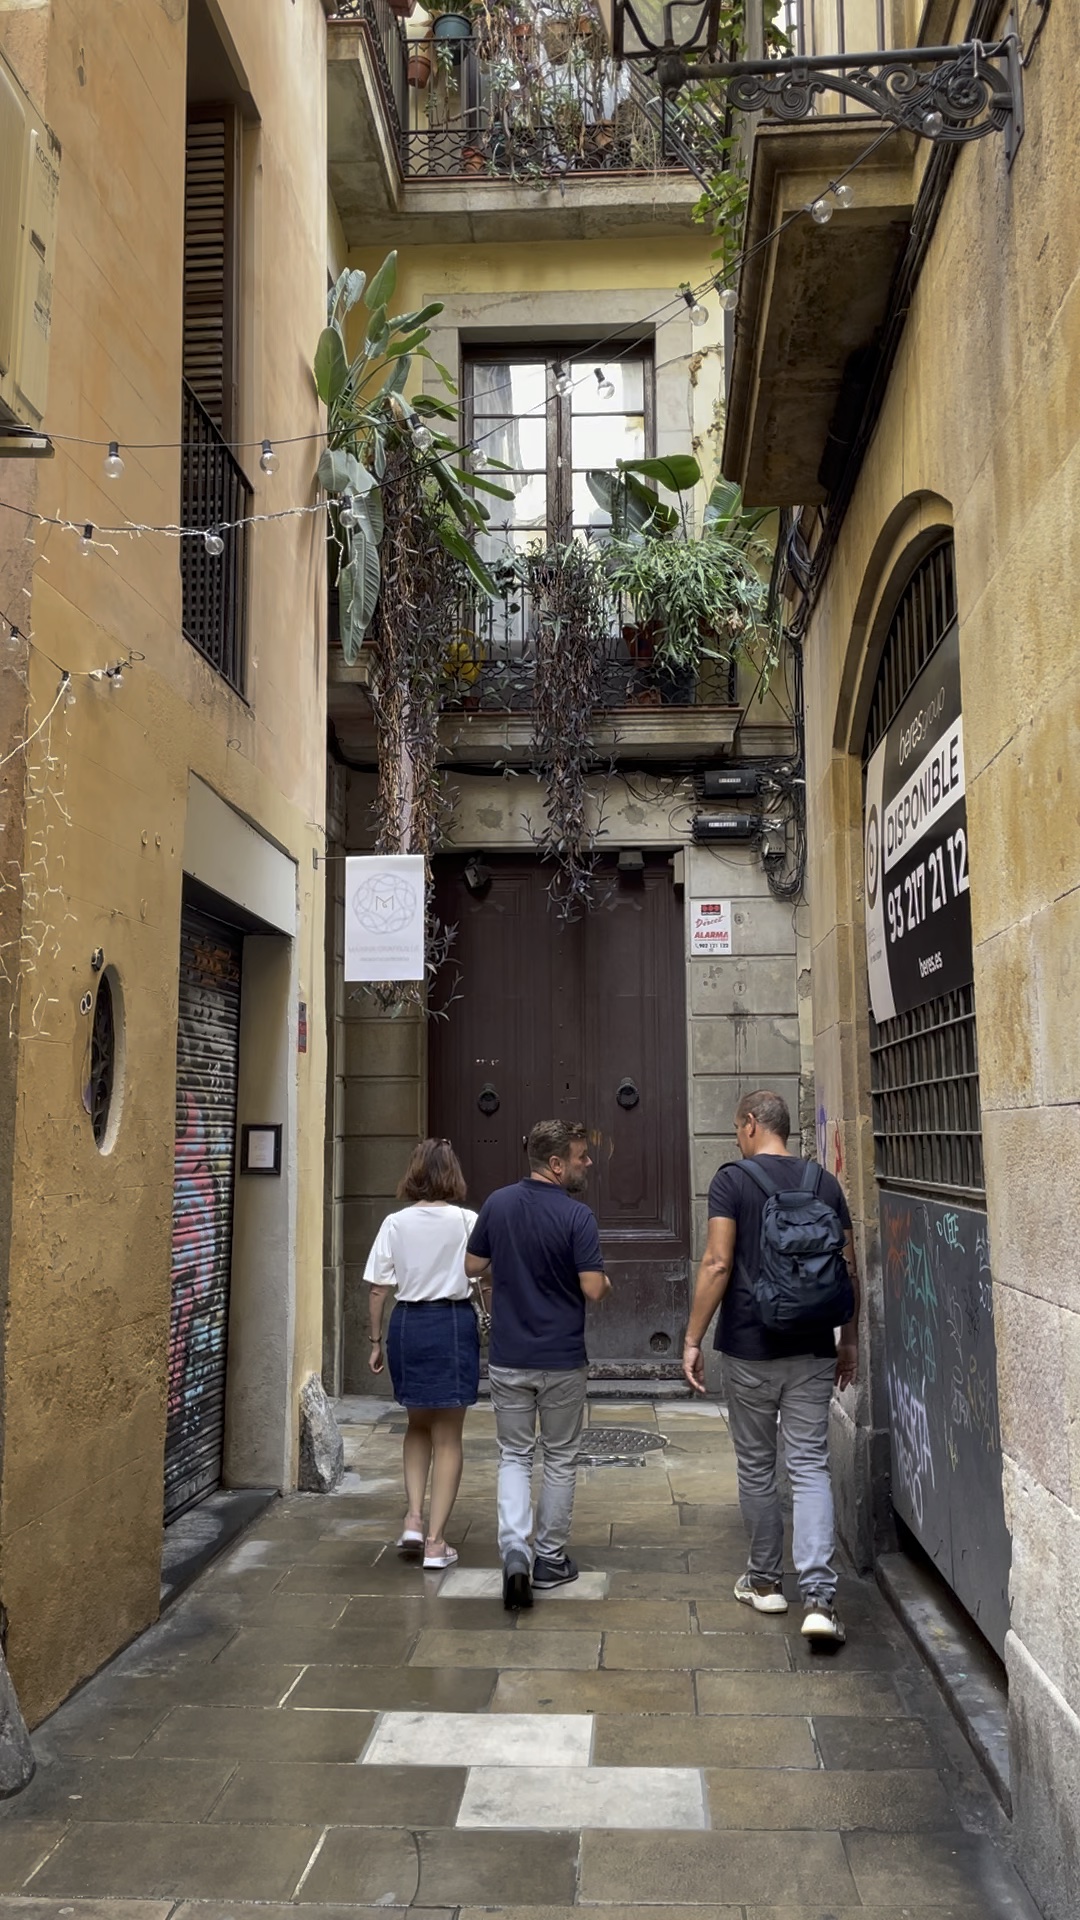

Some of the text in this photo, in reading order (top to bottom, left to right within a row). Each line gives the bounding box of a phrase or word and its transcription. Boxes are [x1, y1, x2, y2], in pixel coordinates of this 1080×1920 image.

[887, 734, 959, 858] DISPONIBLE
[887, 827, 970, 944] 93 217 21 12
[918, 951, 943, 978] beres.es
